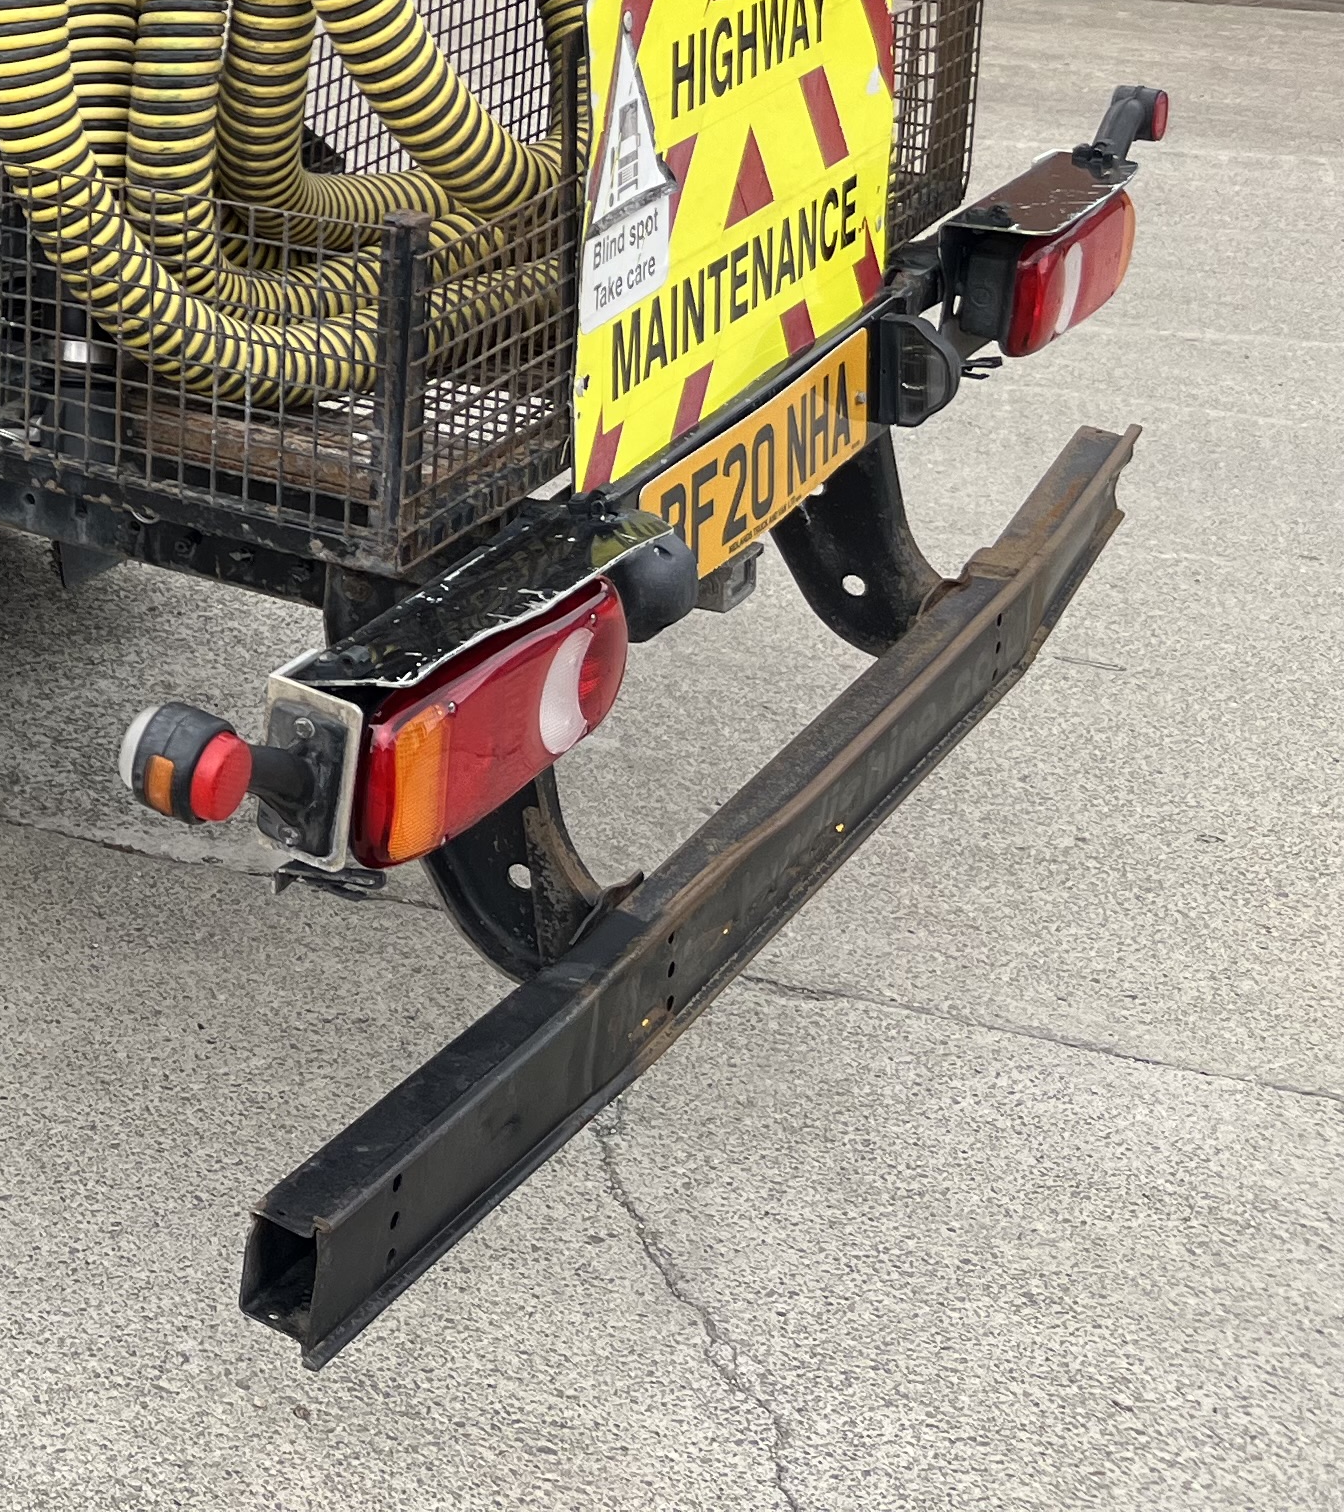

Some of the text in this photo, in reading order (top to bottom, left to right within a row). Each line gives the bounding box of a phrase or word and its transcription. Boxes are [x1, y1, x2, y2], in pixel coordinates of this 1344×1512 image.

[593, 207, 659, 270] Blind spot
[593, 255, 656, 311] Take care
[612, 173, 858, 402] MAINTENANCE
[787, 361, 851, 497] NHA
